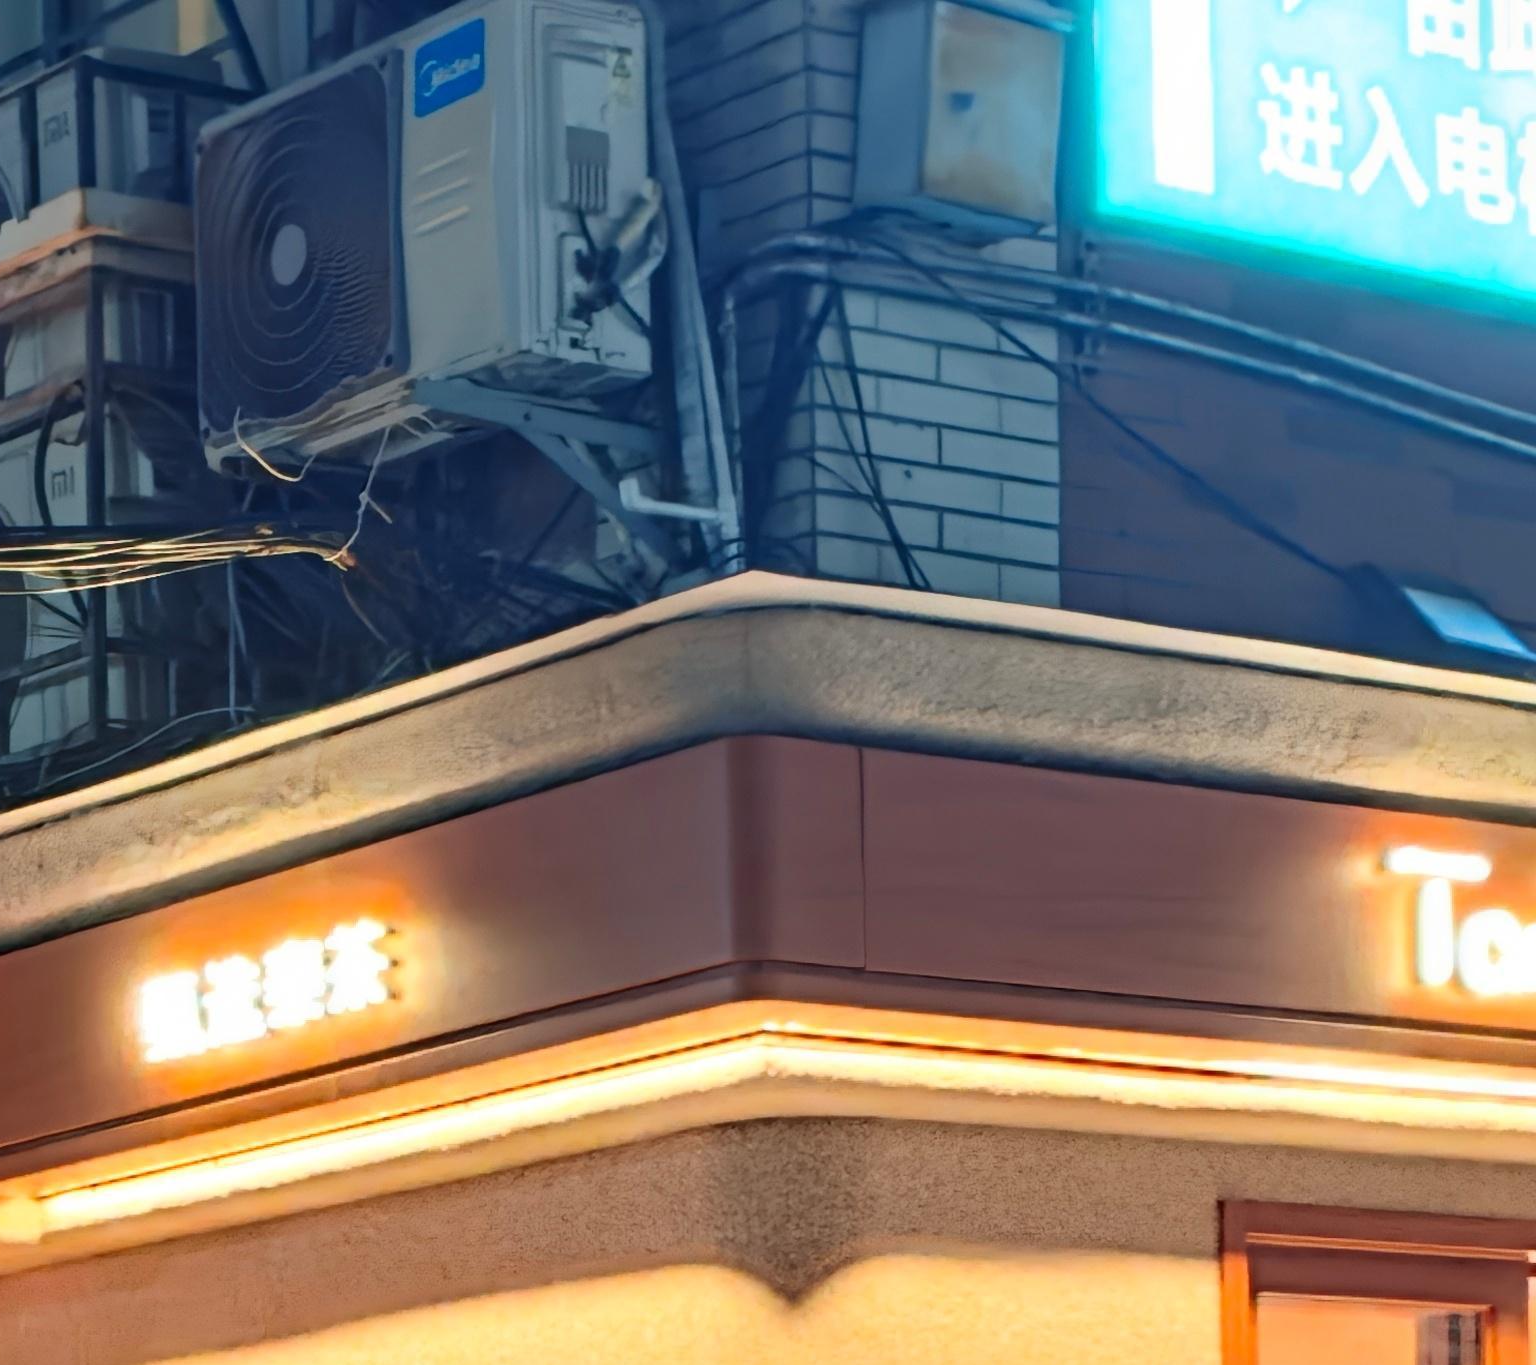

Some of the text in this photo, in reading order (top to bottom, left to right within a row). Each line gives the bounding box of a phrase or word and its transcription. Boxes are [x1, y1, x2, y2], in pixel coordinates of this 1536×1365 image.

[1258, 62, 1536, 237] 进入电
[1385, 846, 1536, 997] Ta
